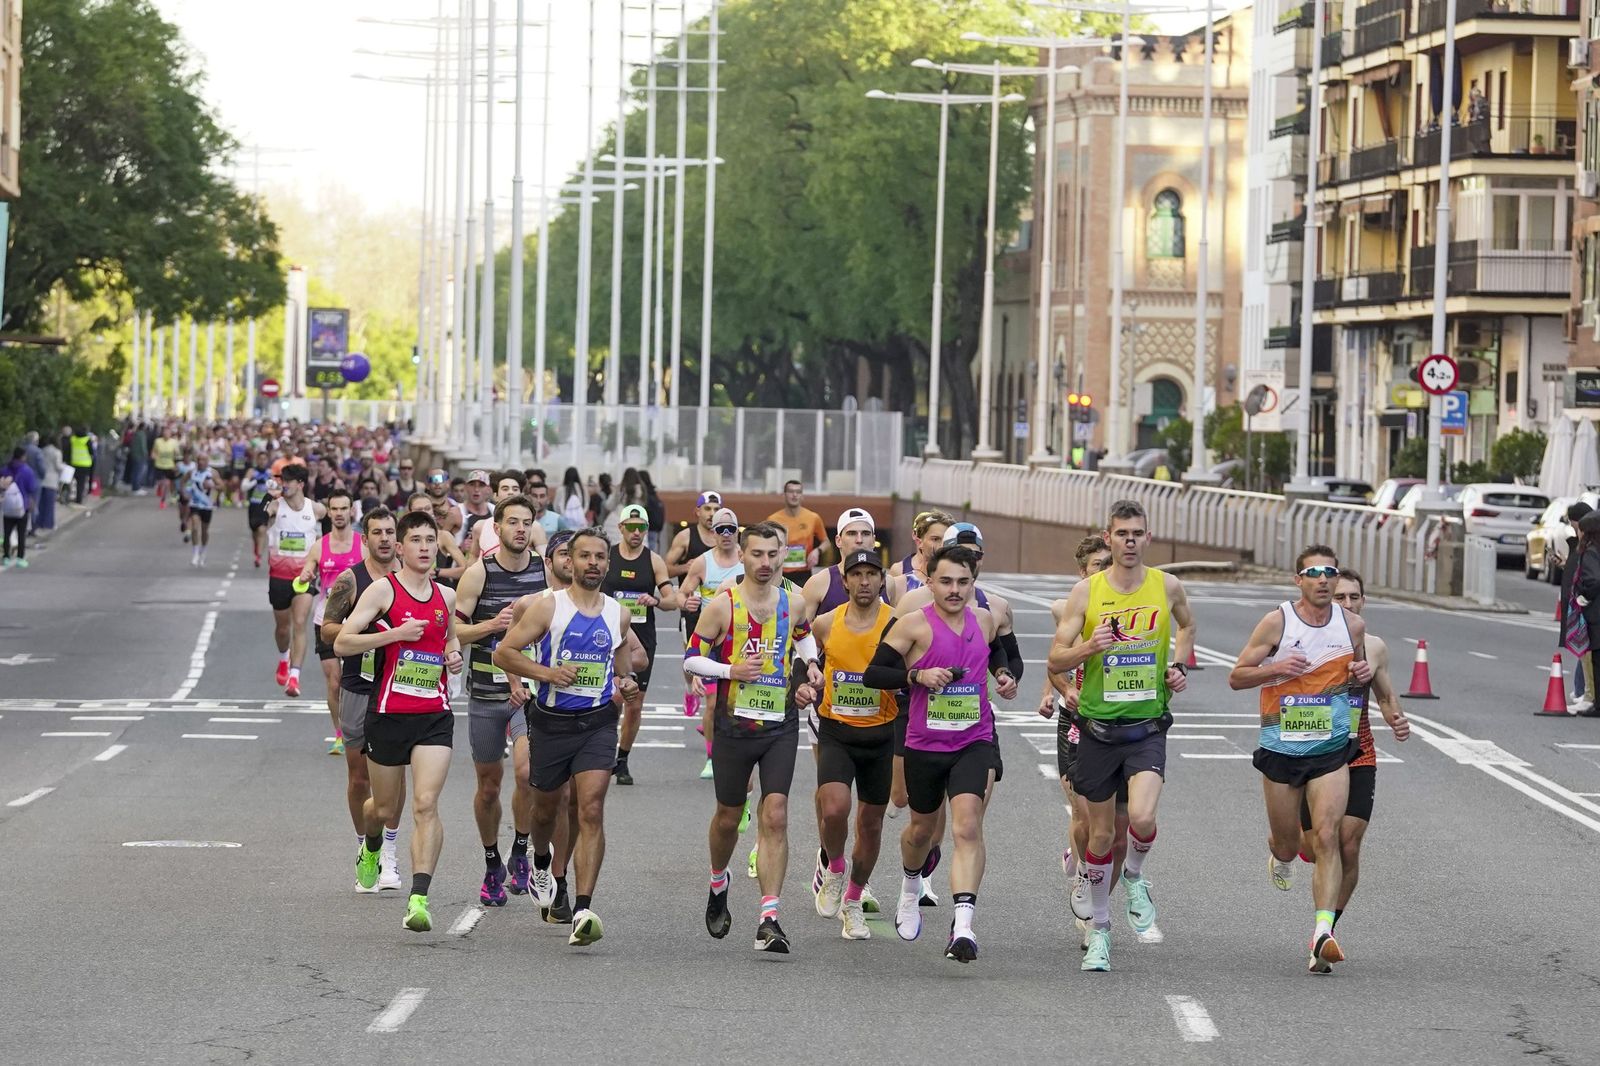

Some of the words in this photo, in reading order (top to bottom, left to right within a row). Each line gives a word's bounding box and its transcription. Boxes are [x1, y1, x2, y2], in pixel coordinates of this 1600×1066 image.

[416, 653, 440, 662] ZURICH
[1121, 655, 1150, 663] ZURICH
[394, 674, 413, 685] LIAM
[577, 676, 599, 686] RENT
[1117, 680, 1144, 690] CLEM
[749, 698, 774, 710] CLEM
[838, 695, 874, 706] PARADA
[928, 711, 945, 719] PAUL
[1285, 719, 1327, 730] RAPHAËL
